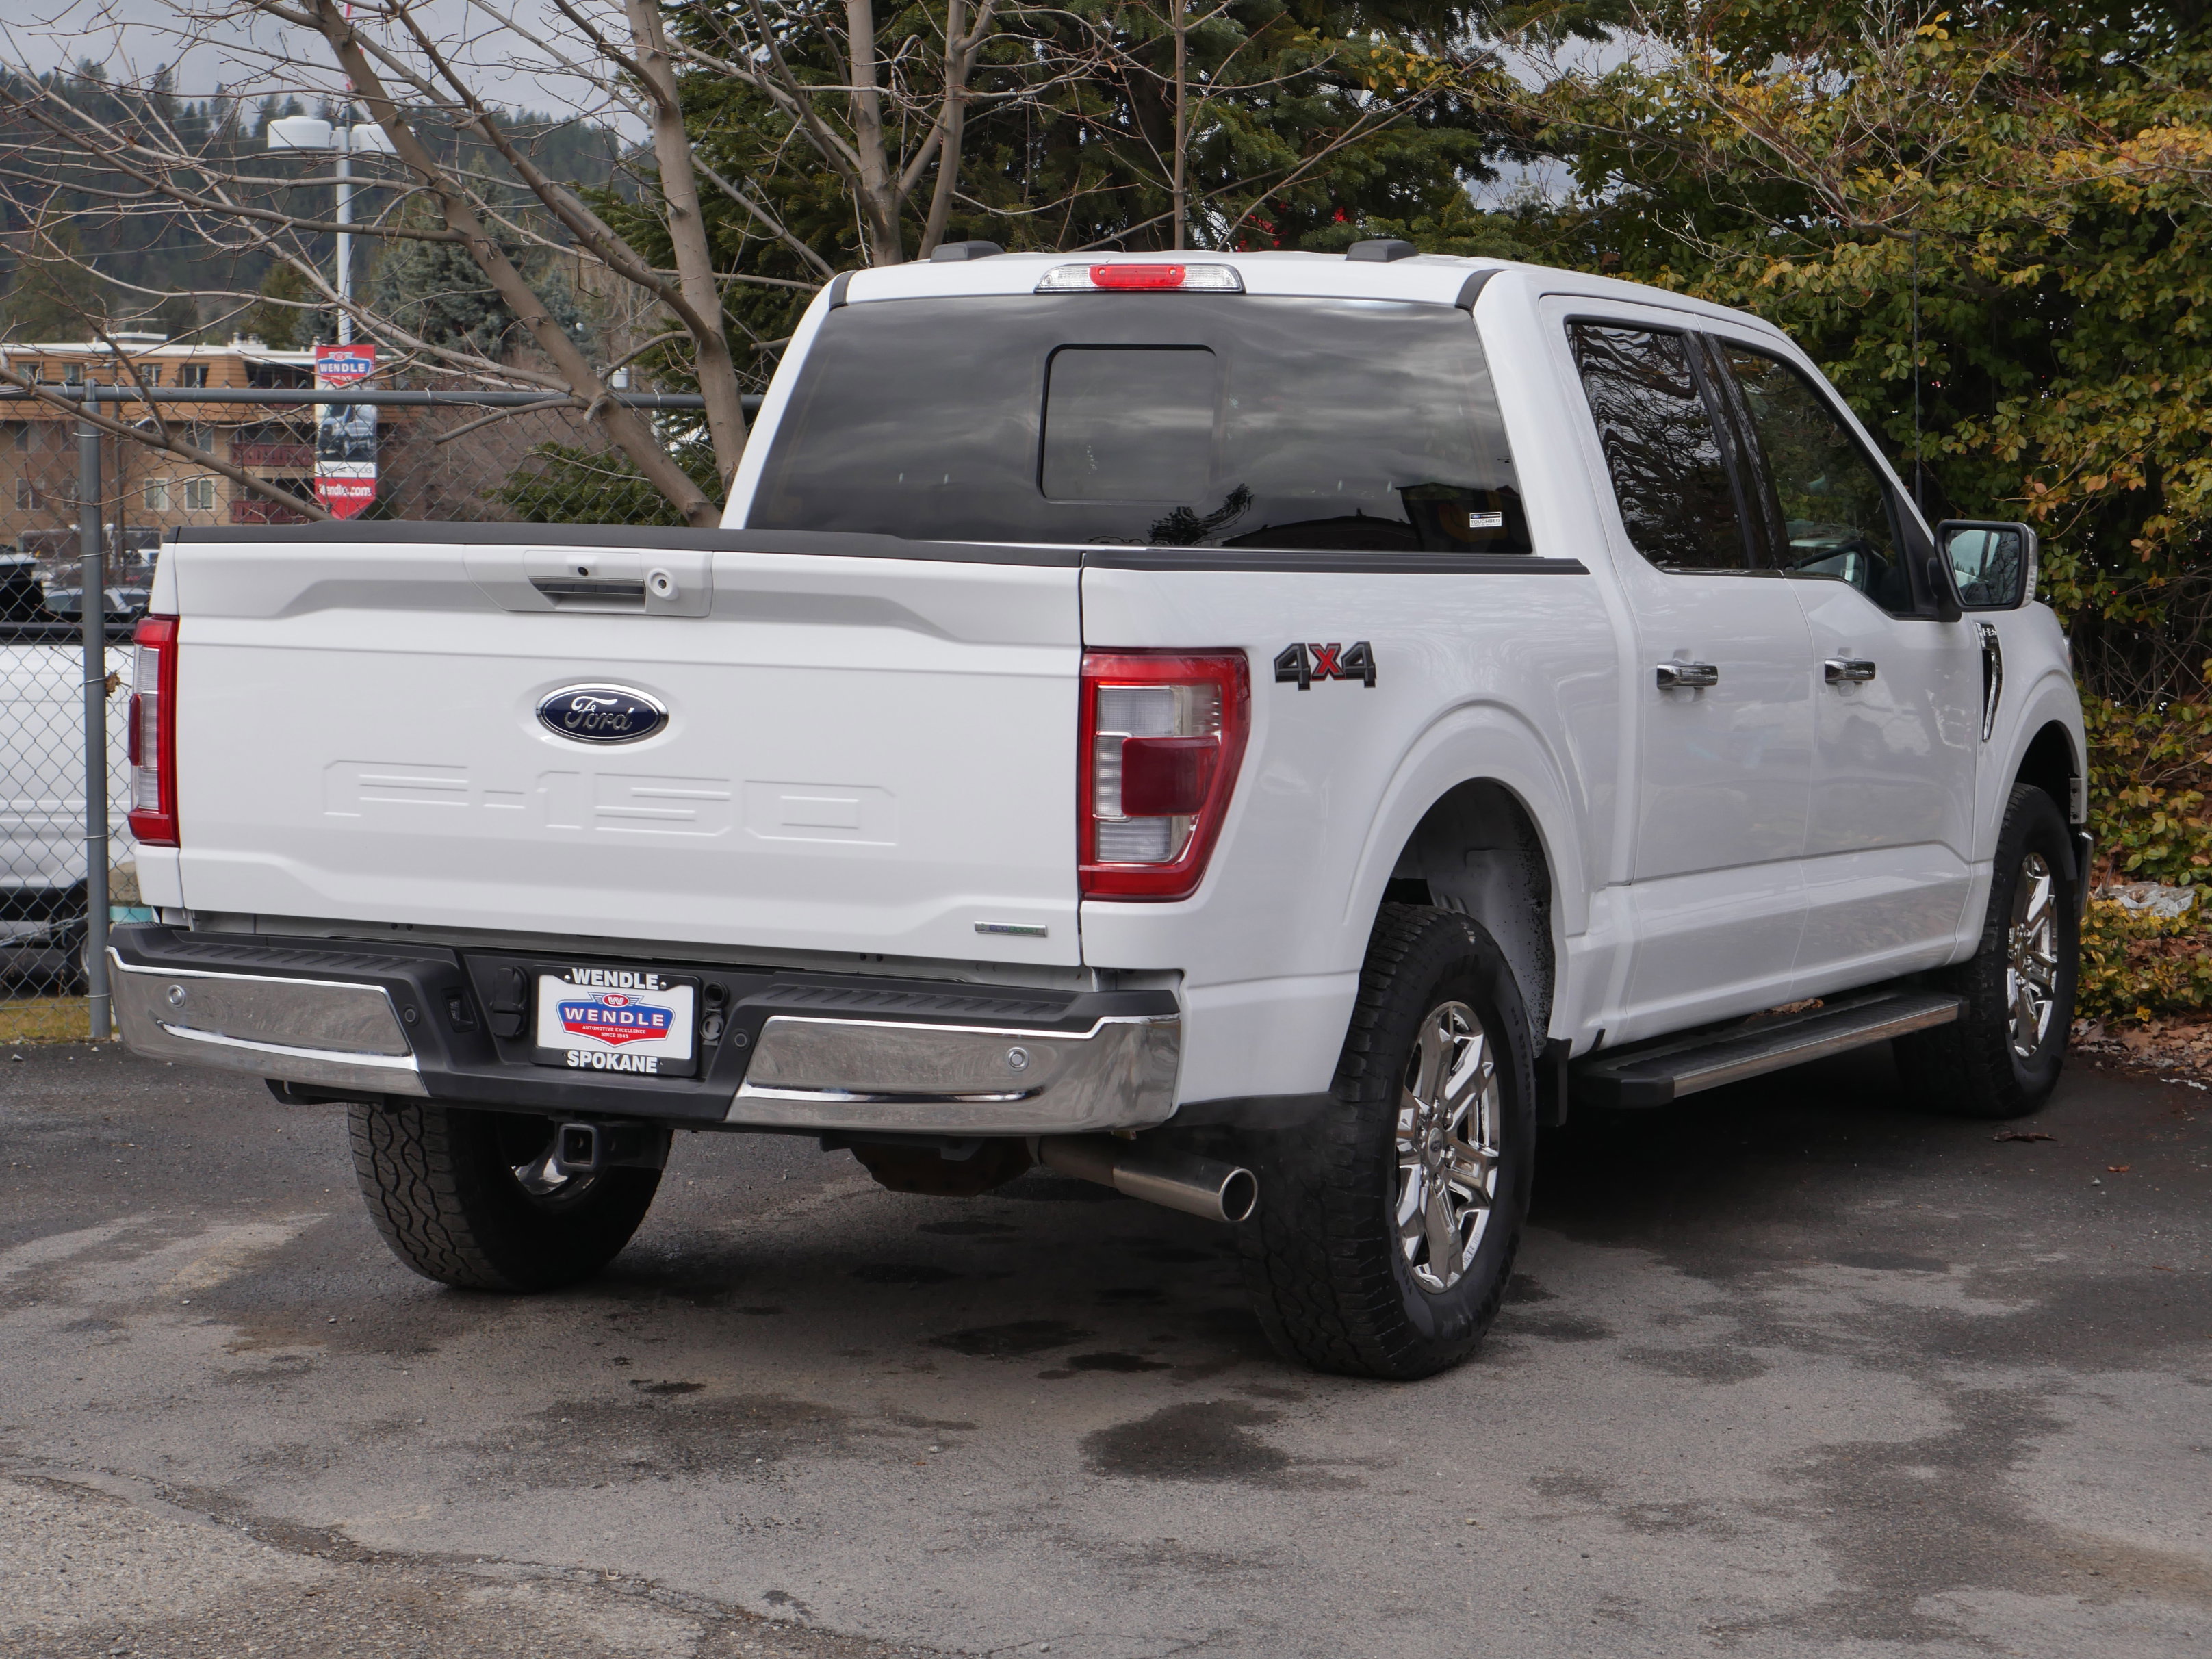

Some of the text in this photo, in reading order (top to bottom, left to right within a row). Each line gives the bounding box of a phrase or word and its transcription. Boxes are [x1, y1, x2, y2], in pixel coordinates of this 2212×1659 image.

[319, 363, 365, 372] WENDLE
[564, 695, 635, 731] Ford
[324, 760, 898, 847] F-150
[571, 968, 658, 990] WENDLE
[565, 1007, 664, 1027] WENDLE
[567, 1050, 658, 1073] SPOKANE
